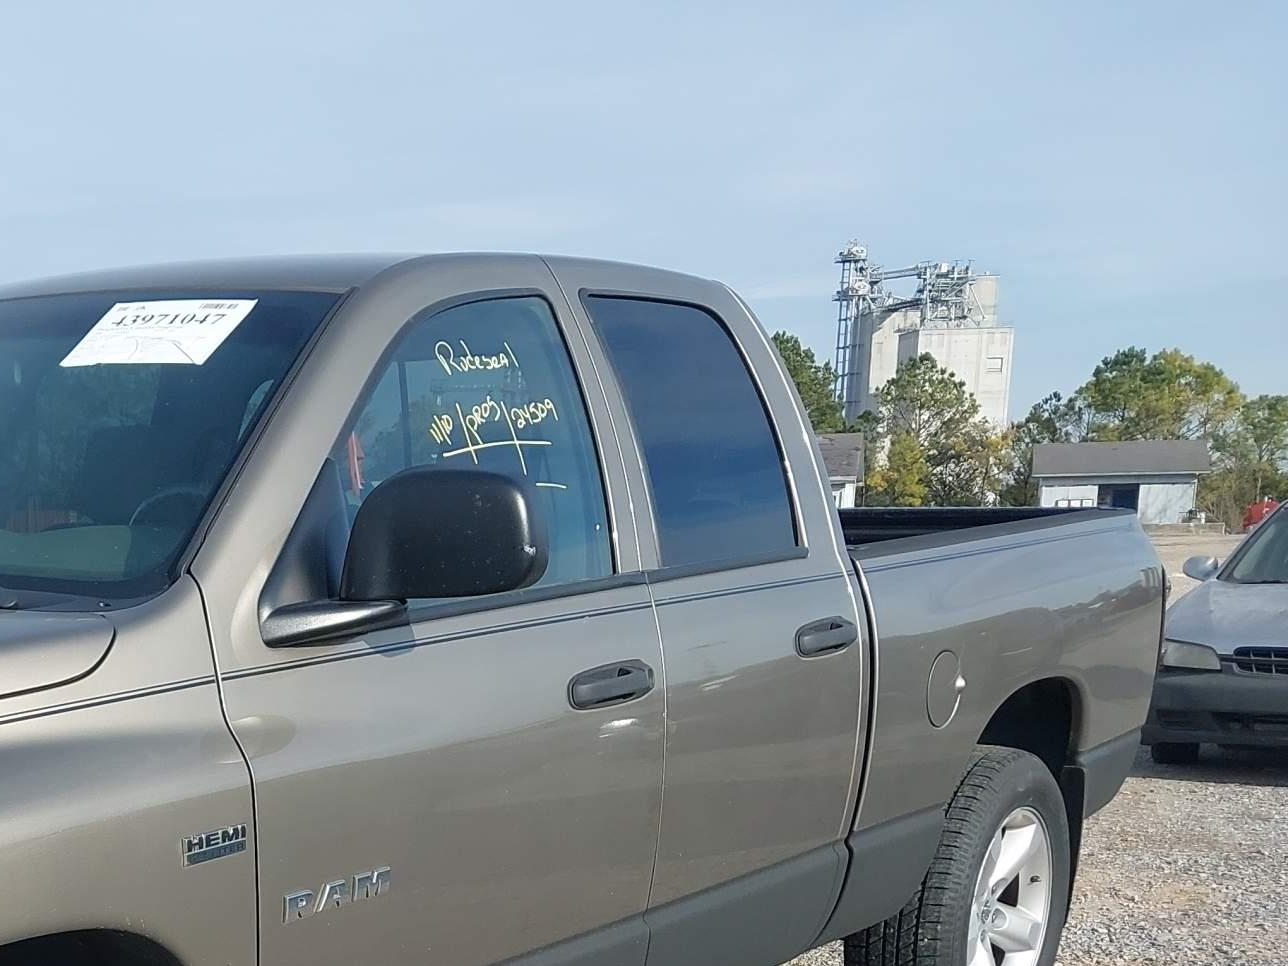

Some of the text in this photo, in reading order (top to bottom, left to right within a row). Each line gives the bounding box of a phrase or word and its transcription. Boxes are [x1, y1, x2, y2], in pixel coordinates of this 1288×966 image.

[112, 313, 227, 327] 43971047
[186, 825, 247, 853] HEMI
[282, 866, 391, 924] RAM
